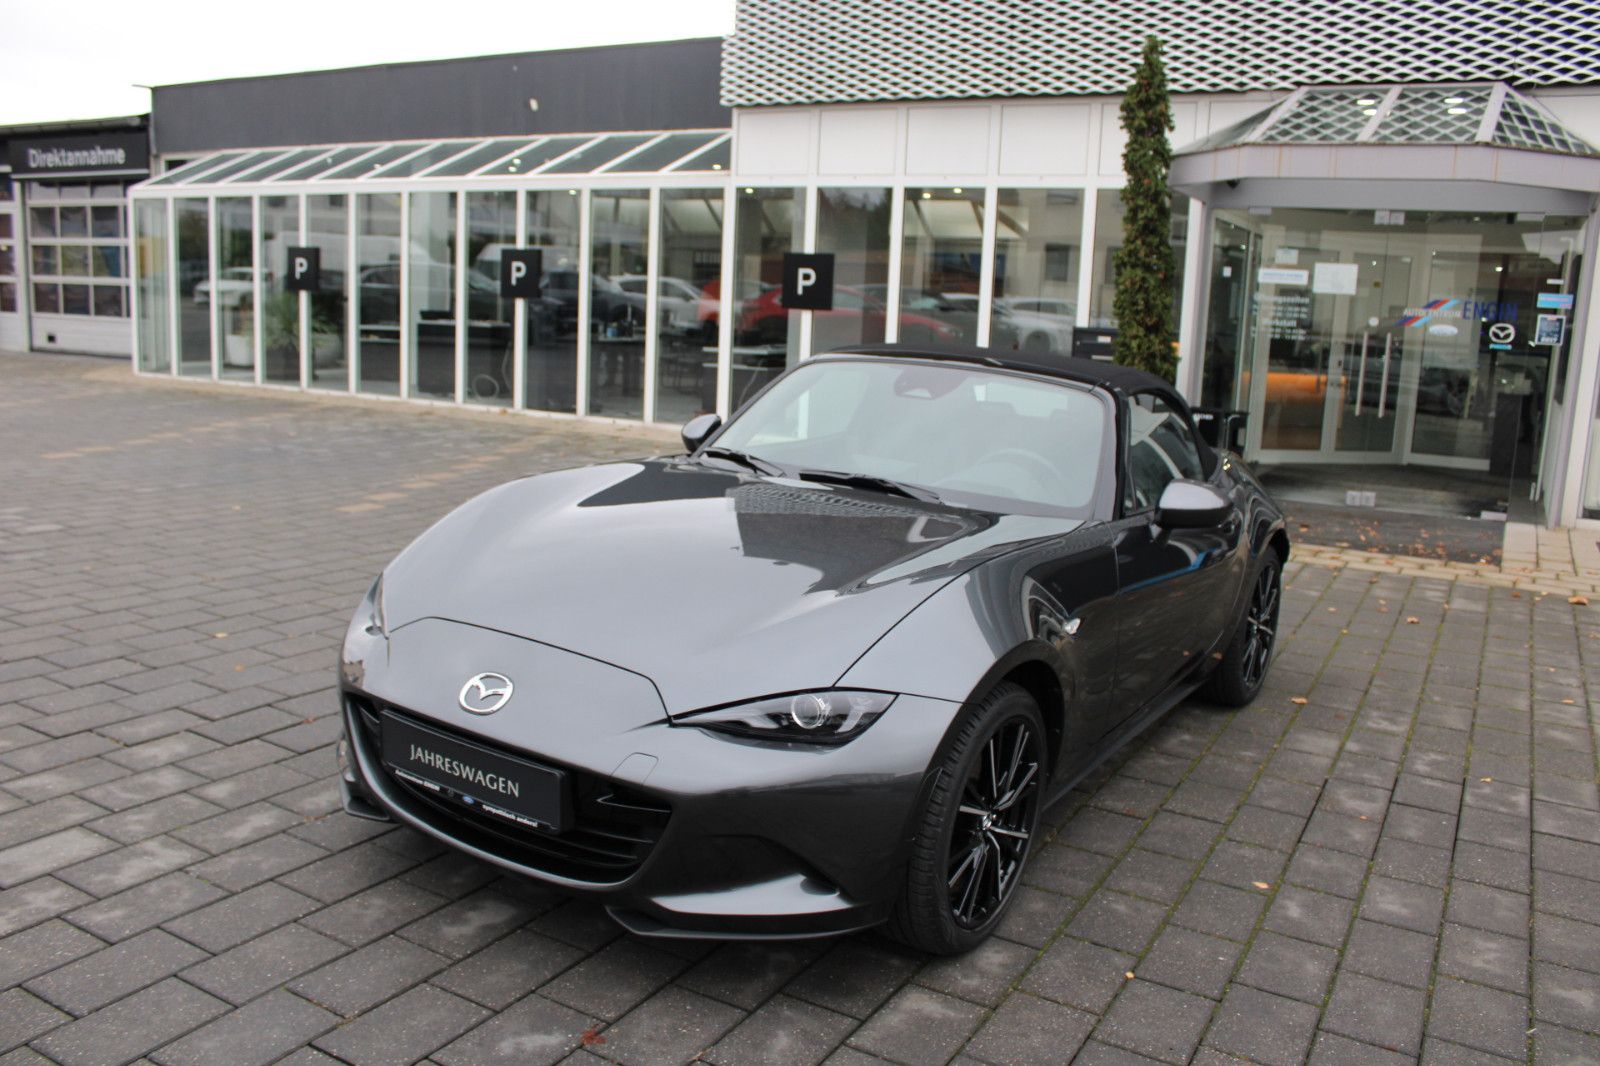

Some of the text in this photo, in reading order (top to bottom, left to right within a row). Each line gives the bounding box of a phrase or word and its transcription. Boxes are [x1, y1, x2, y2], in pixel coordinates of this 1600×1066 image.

[28, 146, 126, 168] Direktannahme
[294, 257, 308, 280] P
[510, 260, 527, 286] P
[797, 267, 817, 296] P
[409, 743, 520, 798] JAHRESWAGEN
